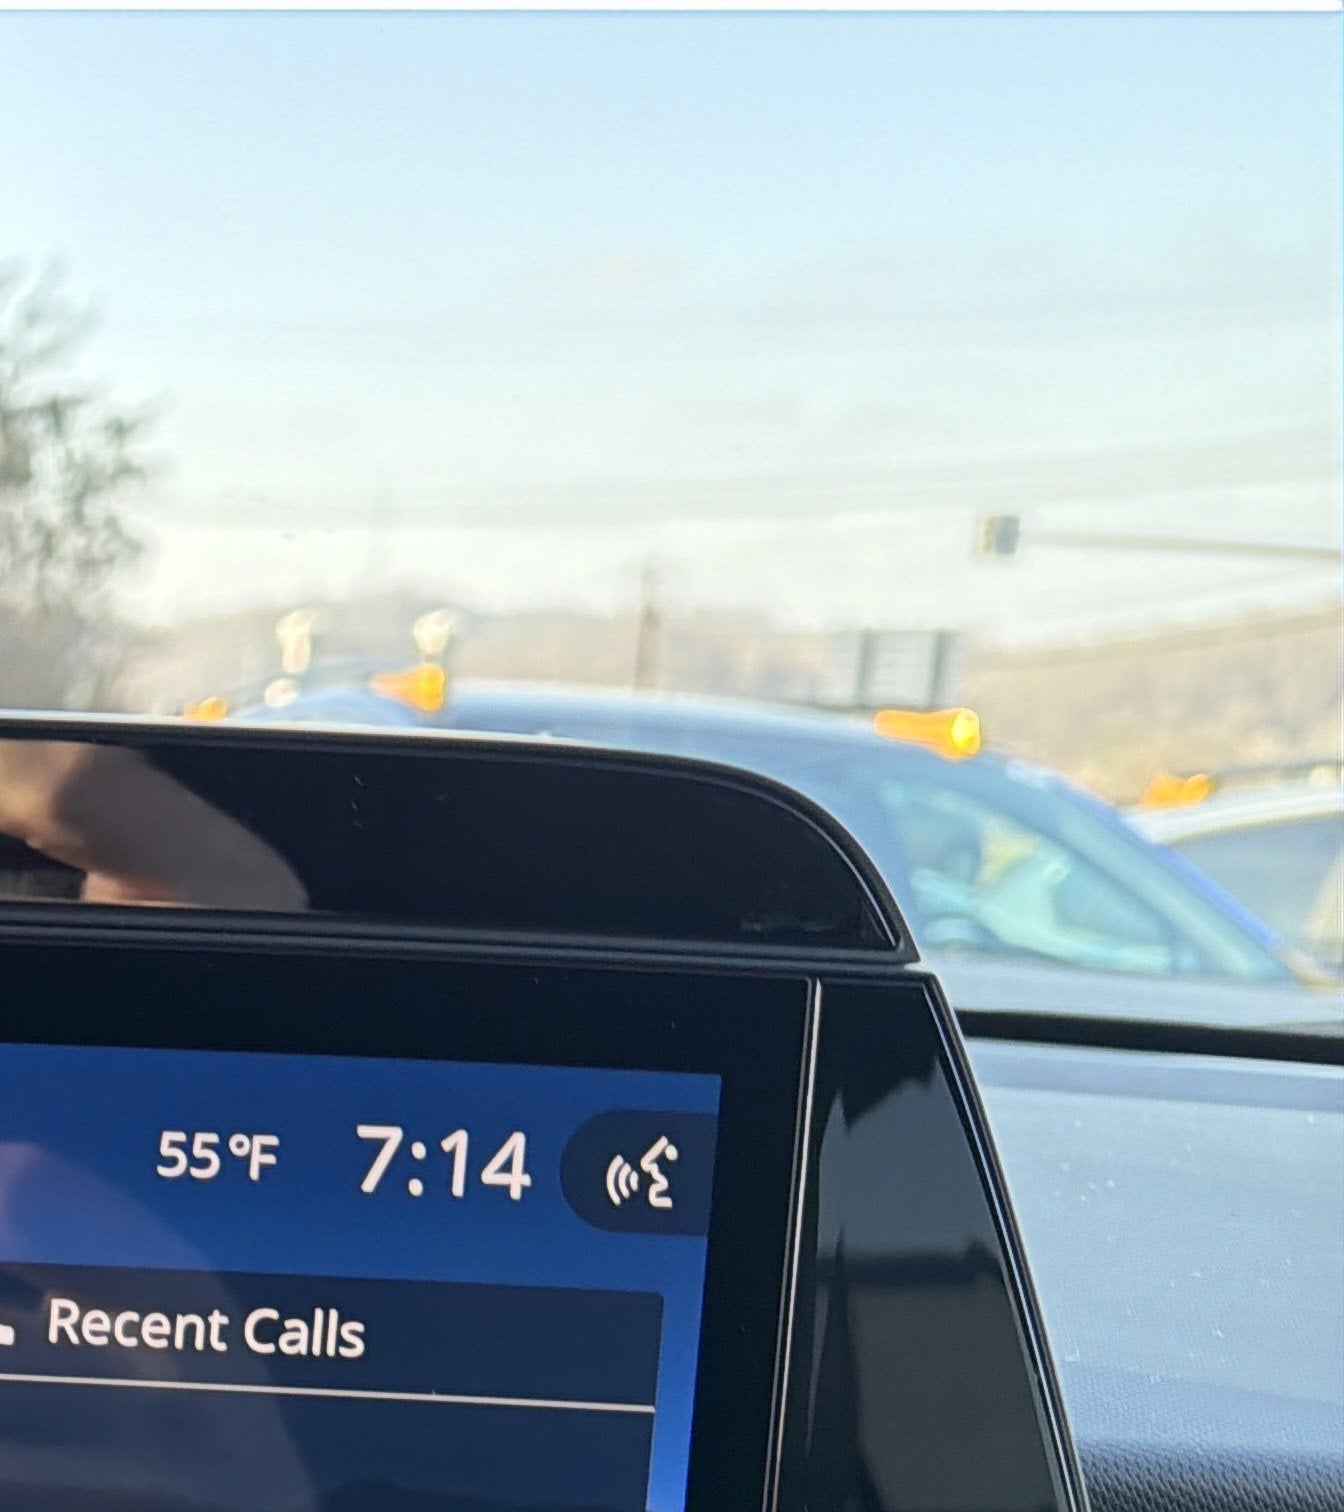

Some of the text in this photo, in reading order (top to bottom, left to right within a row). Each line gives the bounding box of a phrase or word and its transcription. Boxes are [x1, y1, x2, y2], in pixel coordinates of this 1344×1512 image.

[356, 1124, 532, 1201] 7:14
[48, 1297, 365, 1358] Recent Calls
